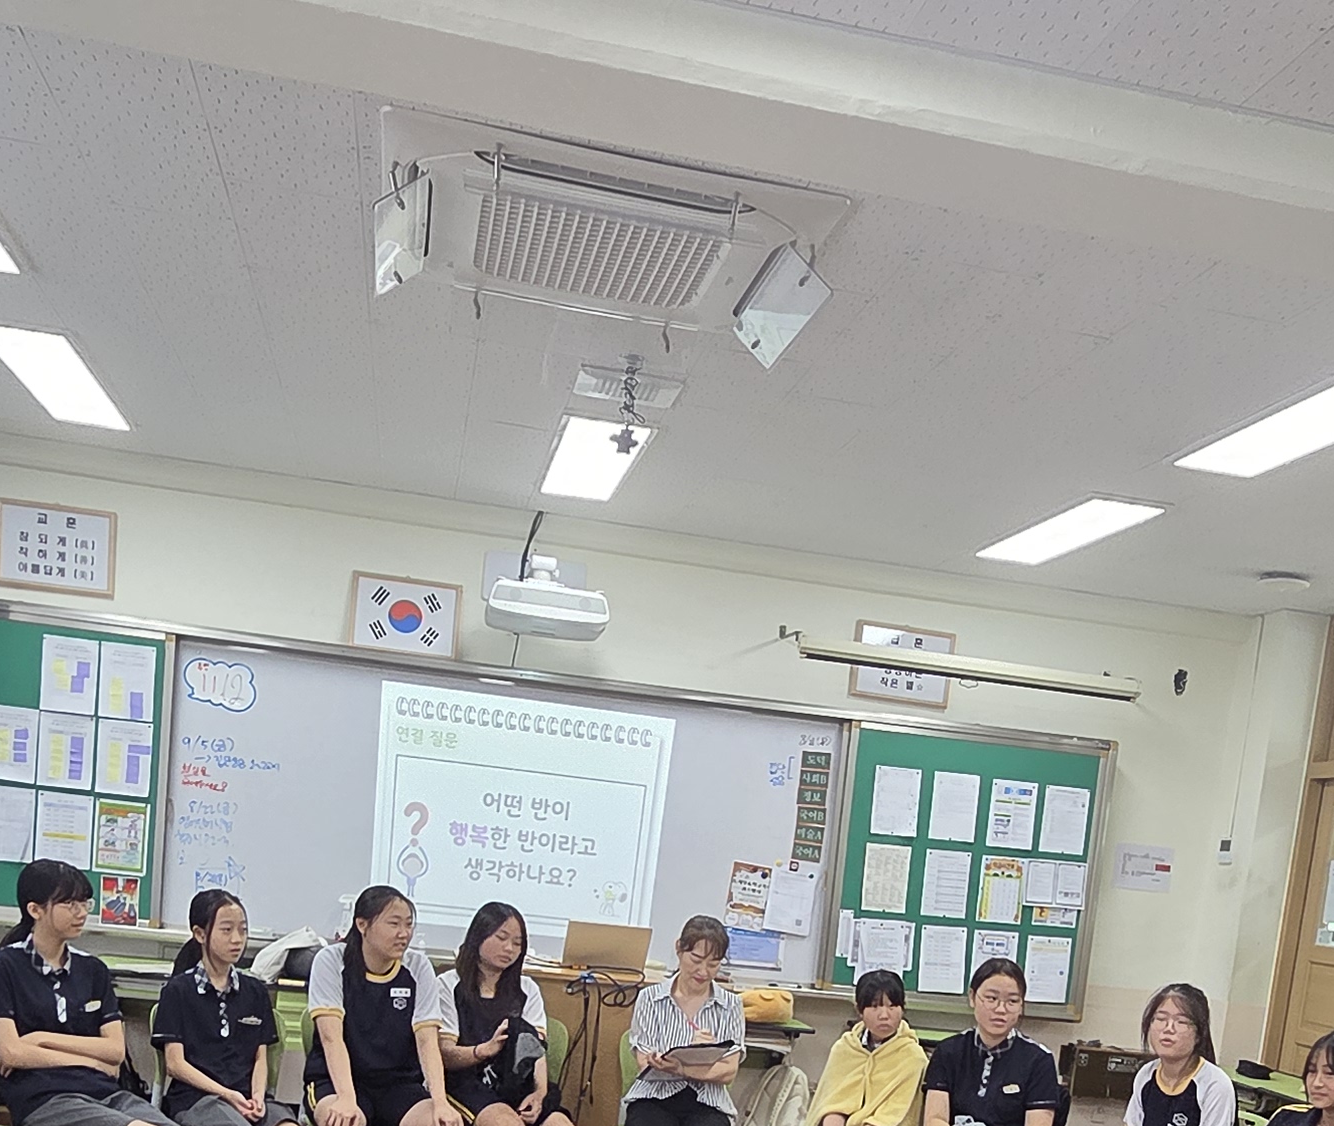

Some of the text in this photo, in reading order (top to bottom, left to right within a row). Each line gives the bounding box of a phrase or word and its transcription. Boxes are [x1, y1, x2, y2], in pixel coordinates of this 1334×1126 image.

[396, 725, 458, 749] 연결 질문
[806, 755, 826, 766] 도덕
[802, 772, 827, 784] 사회B
[803, 791, 821, 802] 정보
[483, 792, 571, 821] 어떤 반이
[799, 809, 824, 821] 국어B
[448, 820, 598, 857] 행복한 반이라고
[797, 827, 822, 840] 미술A
[795, 844, 820, 859] 국어A
[464, 857, 577, 888] 생각하나요?
